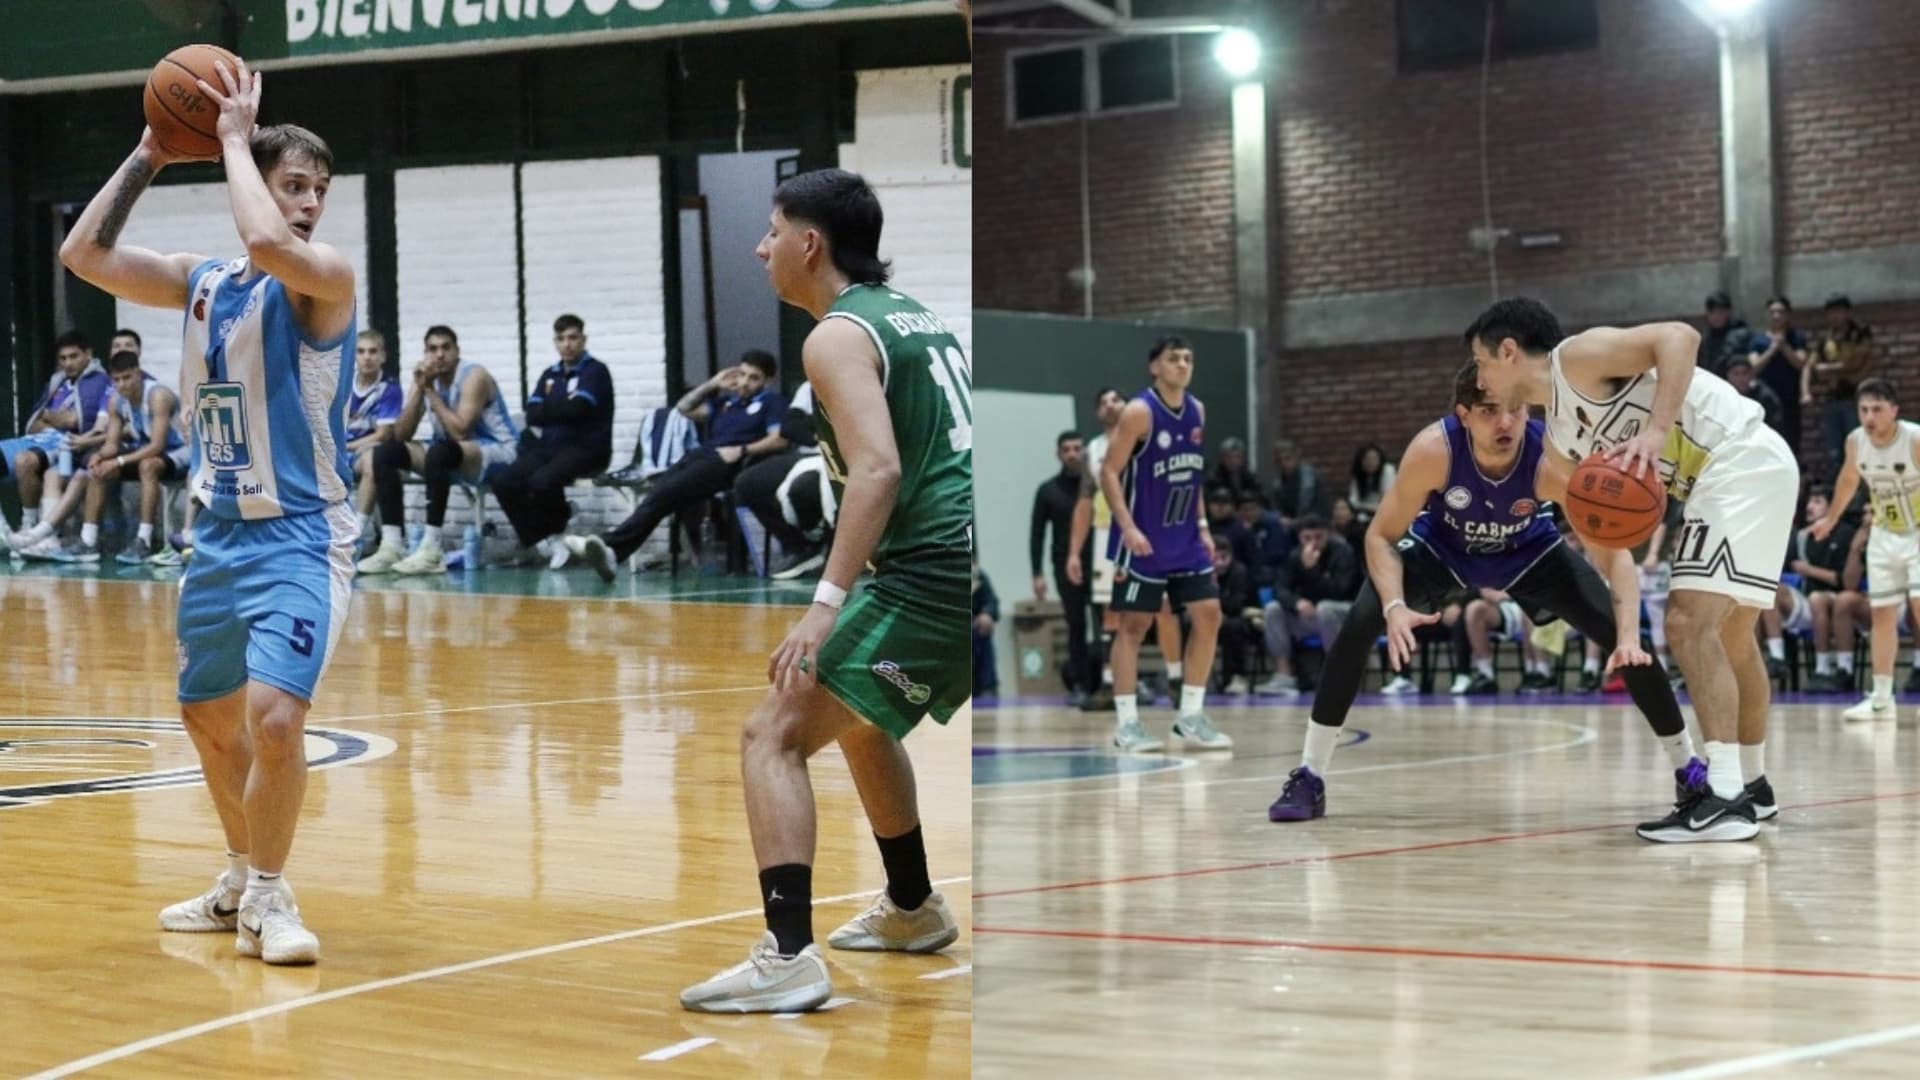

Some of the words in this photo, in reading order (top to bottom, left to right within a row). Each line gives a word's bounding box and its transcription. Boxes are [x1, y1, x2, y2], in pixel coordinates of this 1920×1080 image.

[1464, 516, 1531, 539] CARMEN
[1677, 524, 1710, 562] 11
[288, 616, 317, 659] 5
